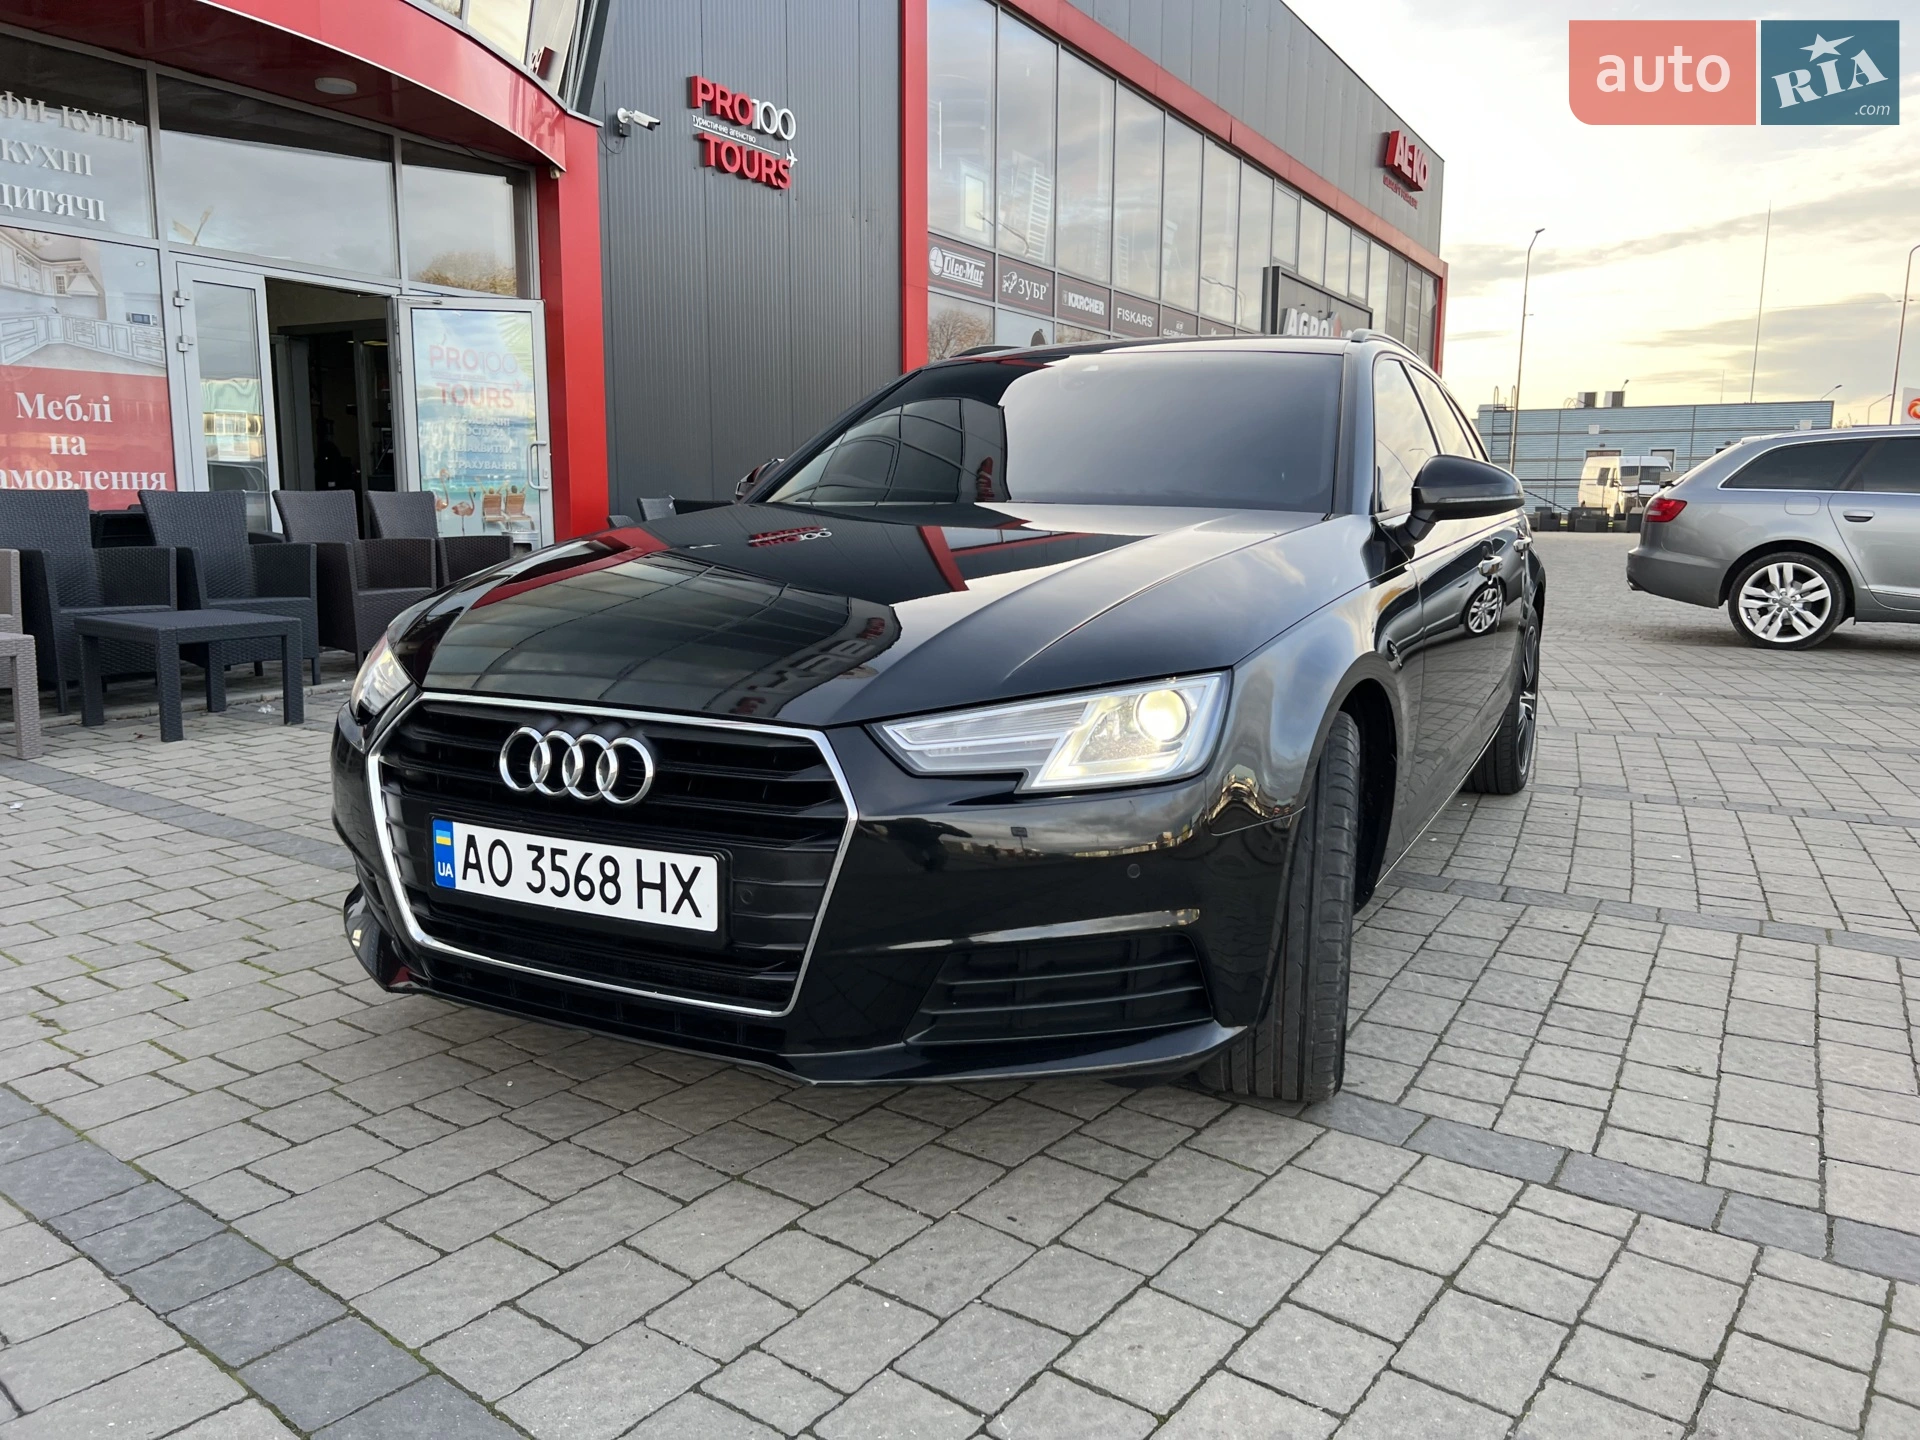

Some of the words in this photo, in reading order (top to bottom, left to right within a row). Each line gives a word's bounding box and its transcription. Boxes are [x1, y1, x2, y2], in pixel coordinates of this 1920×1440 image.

[691, 75, 797, 141] PRO100
[692, 114, 729, 134] туристичне
[0, 139, 93, 176] КУХНІ
[698, 132, 792, 190] TOURS
[943, 255, 985, 283] Oleo-Mac
[1018, 278, 1047, 300] ЗУБР
[1116, 307, 1153, 328] FISKARS
[429, 345, 518, 374] PRO100
[15, 391, 113, 423] Меблі
[436, 382, 515, 409] TOURS
[48, 435, 88, 456] на
[437, 863, 454, 878] UA
[461, 834, 513, 887] AO
[526, 843, 622, 905] 3568
[636, 858, 703, 918] HX
